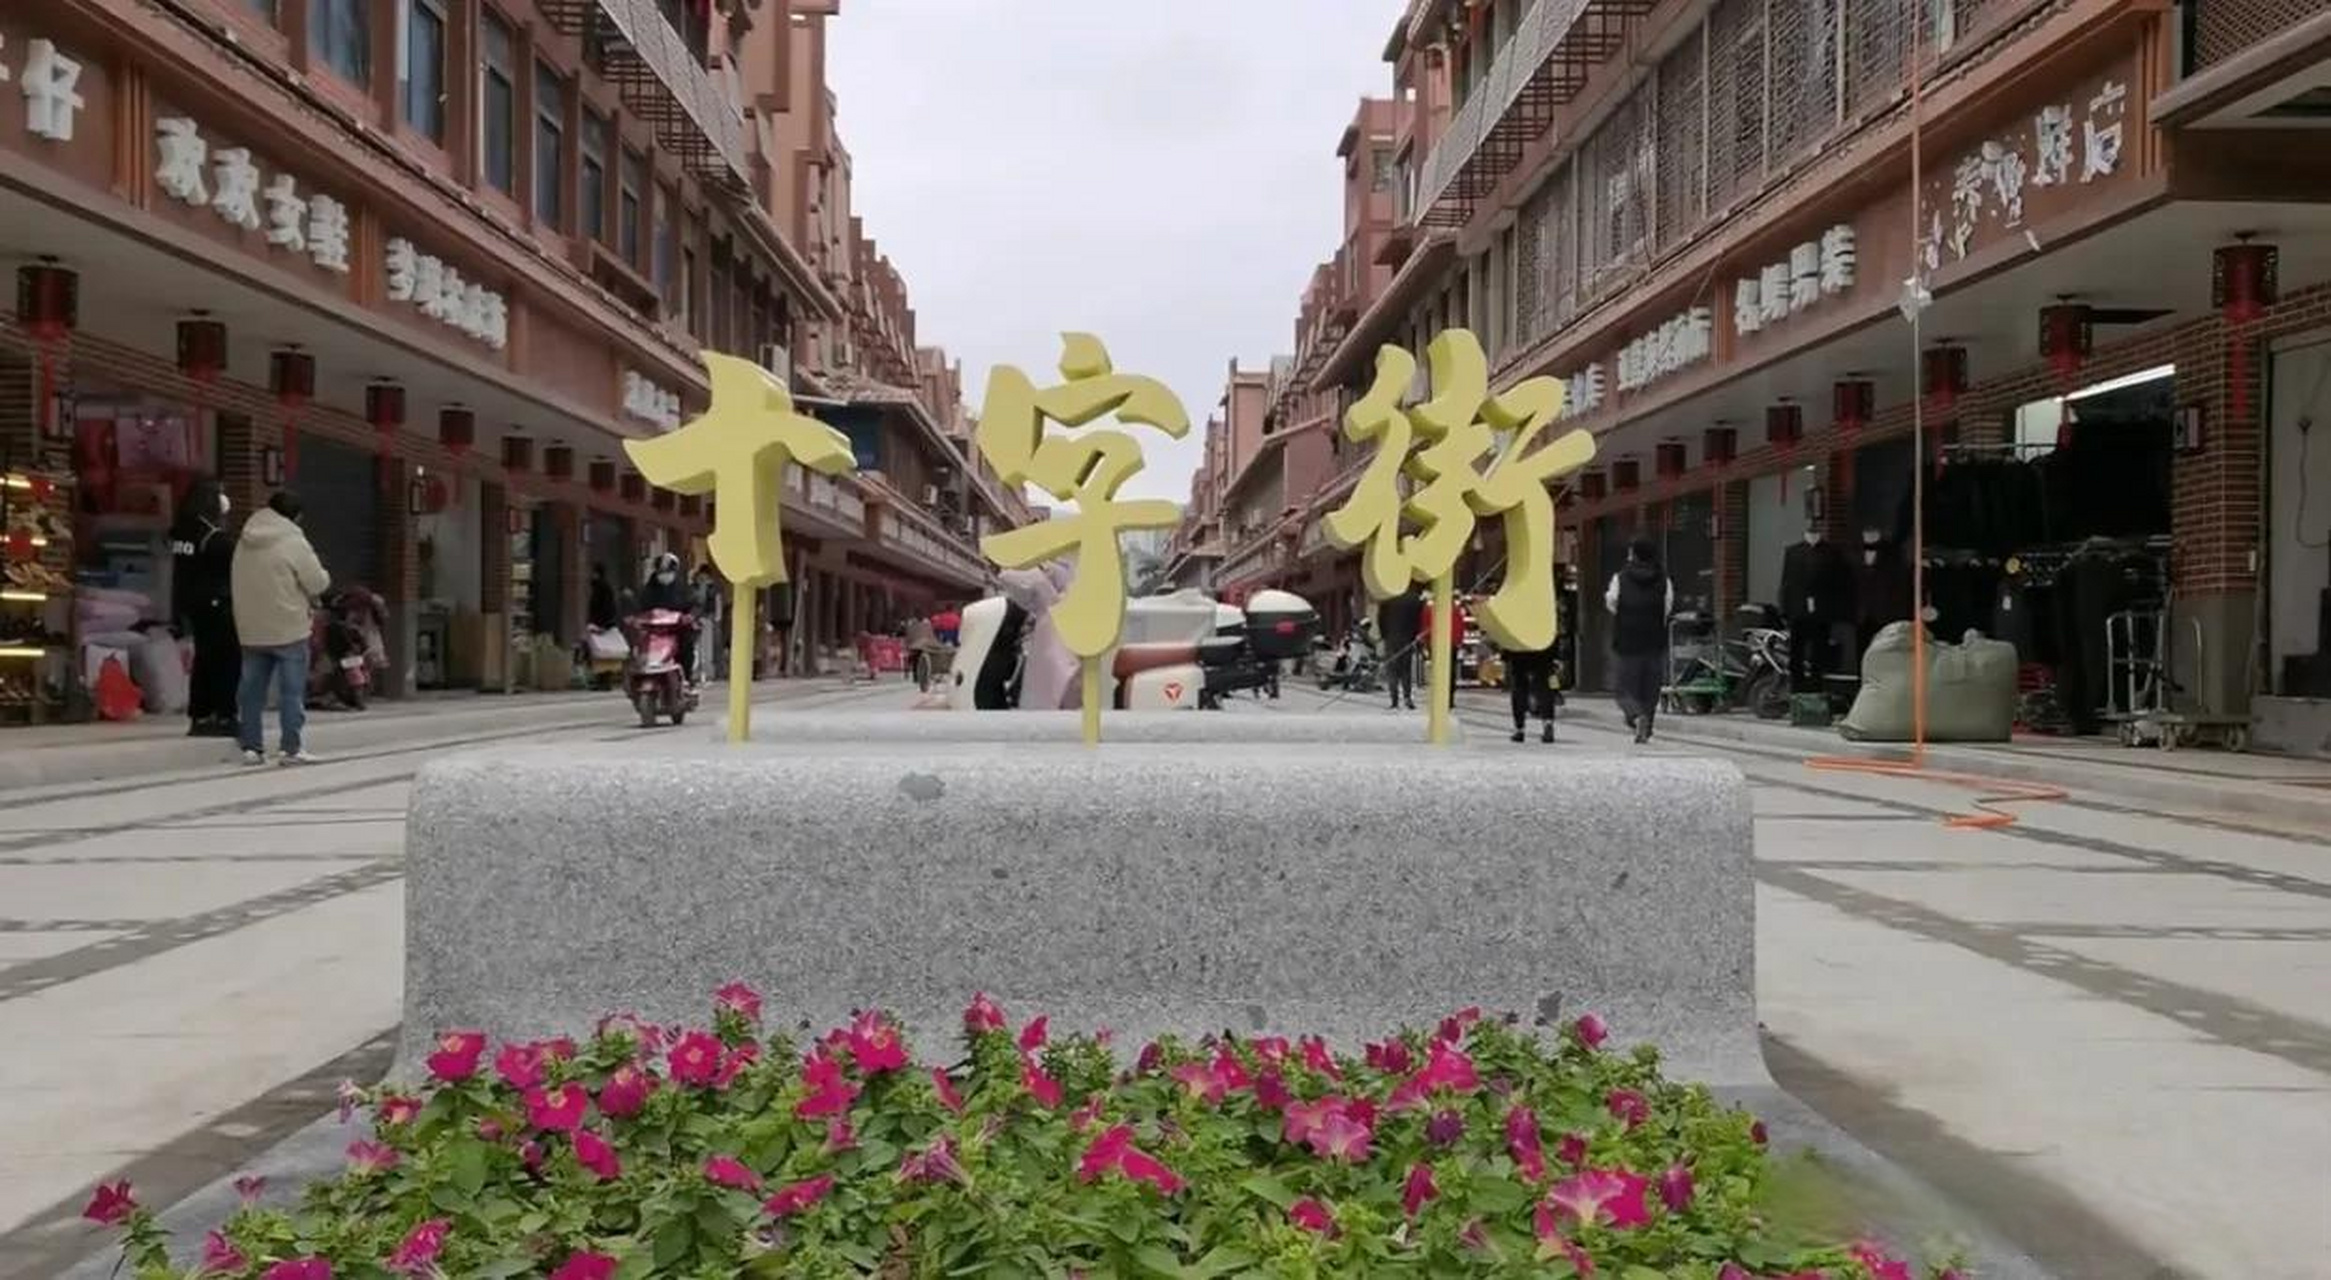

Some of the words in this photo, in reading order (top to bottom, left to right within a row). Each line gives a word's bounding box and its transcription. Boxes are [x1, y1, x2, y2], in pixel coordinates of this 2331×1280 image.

[0, 34, 84, 141] 仔
[623, 328, 1596, 656] 十字街
